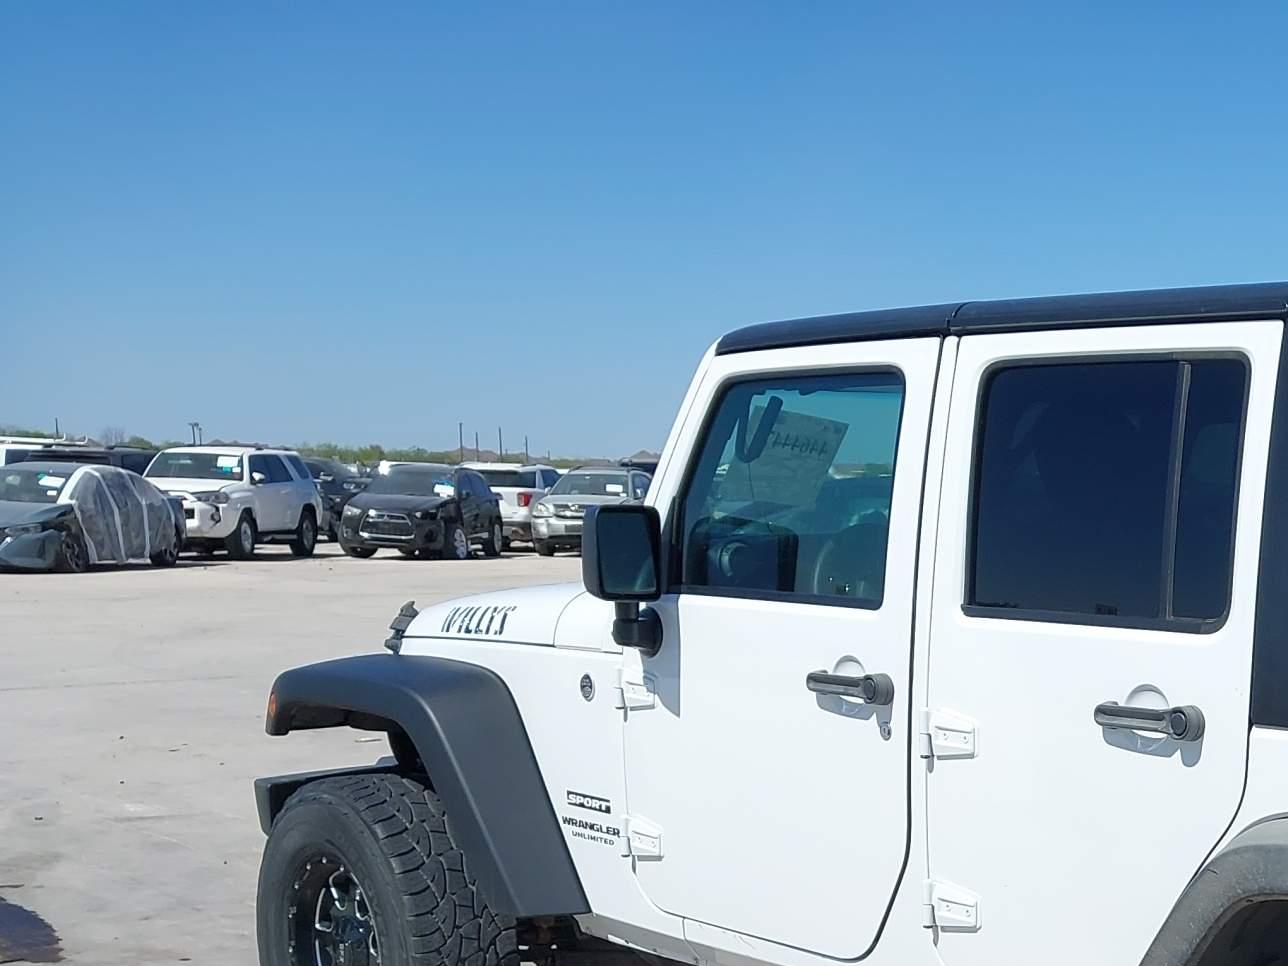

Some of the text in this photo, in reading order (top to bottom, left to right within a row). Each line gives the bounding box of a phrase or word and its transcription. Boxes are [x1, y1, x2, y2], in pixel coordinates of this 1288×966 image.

[440, 606, 518, 636] WILLYS
[567, 792, 610, 813] SPORT
[561, 815, 621, 838] WRANGLER
[571, 830, 615, 846] UNLIMITED
